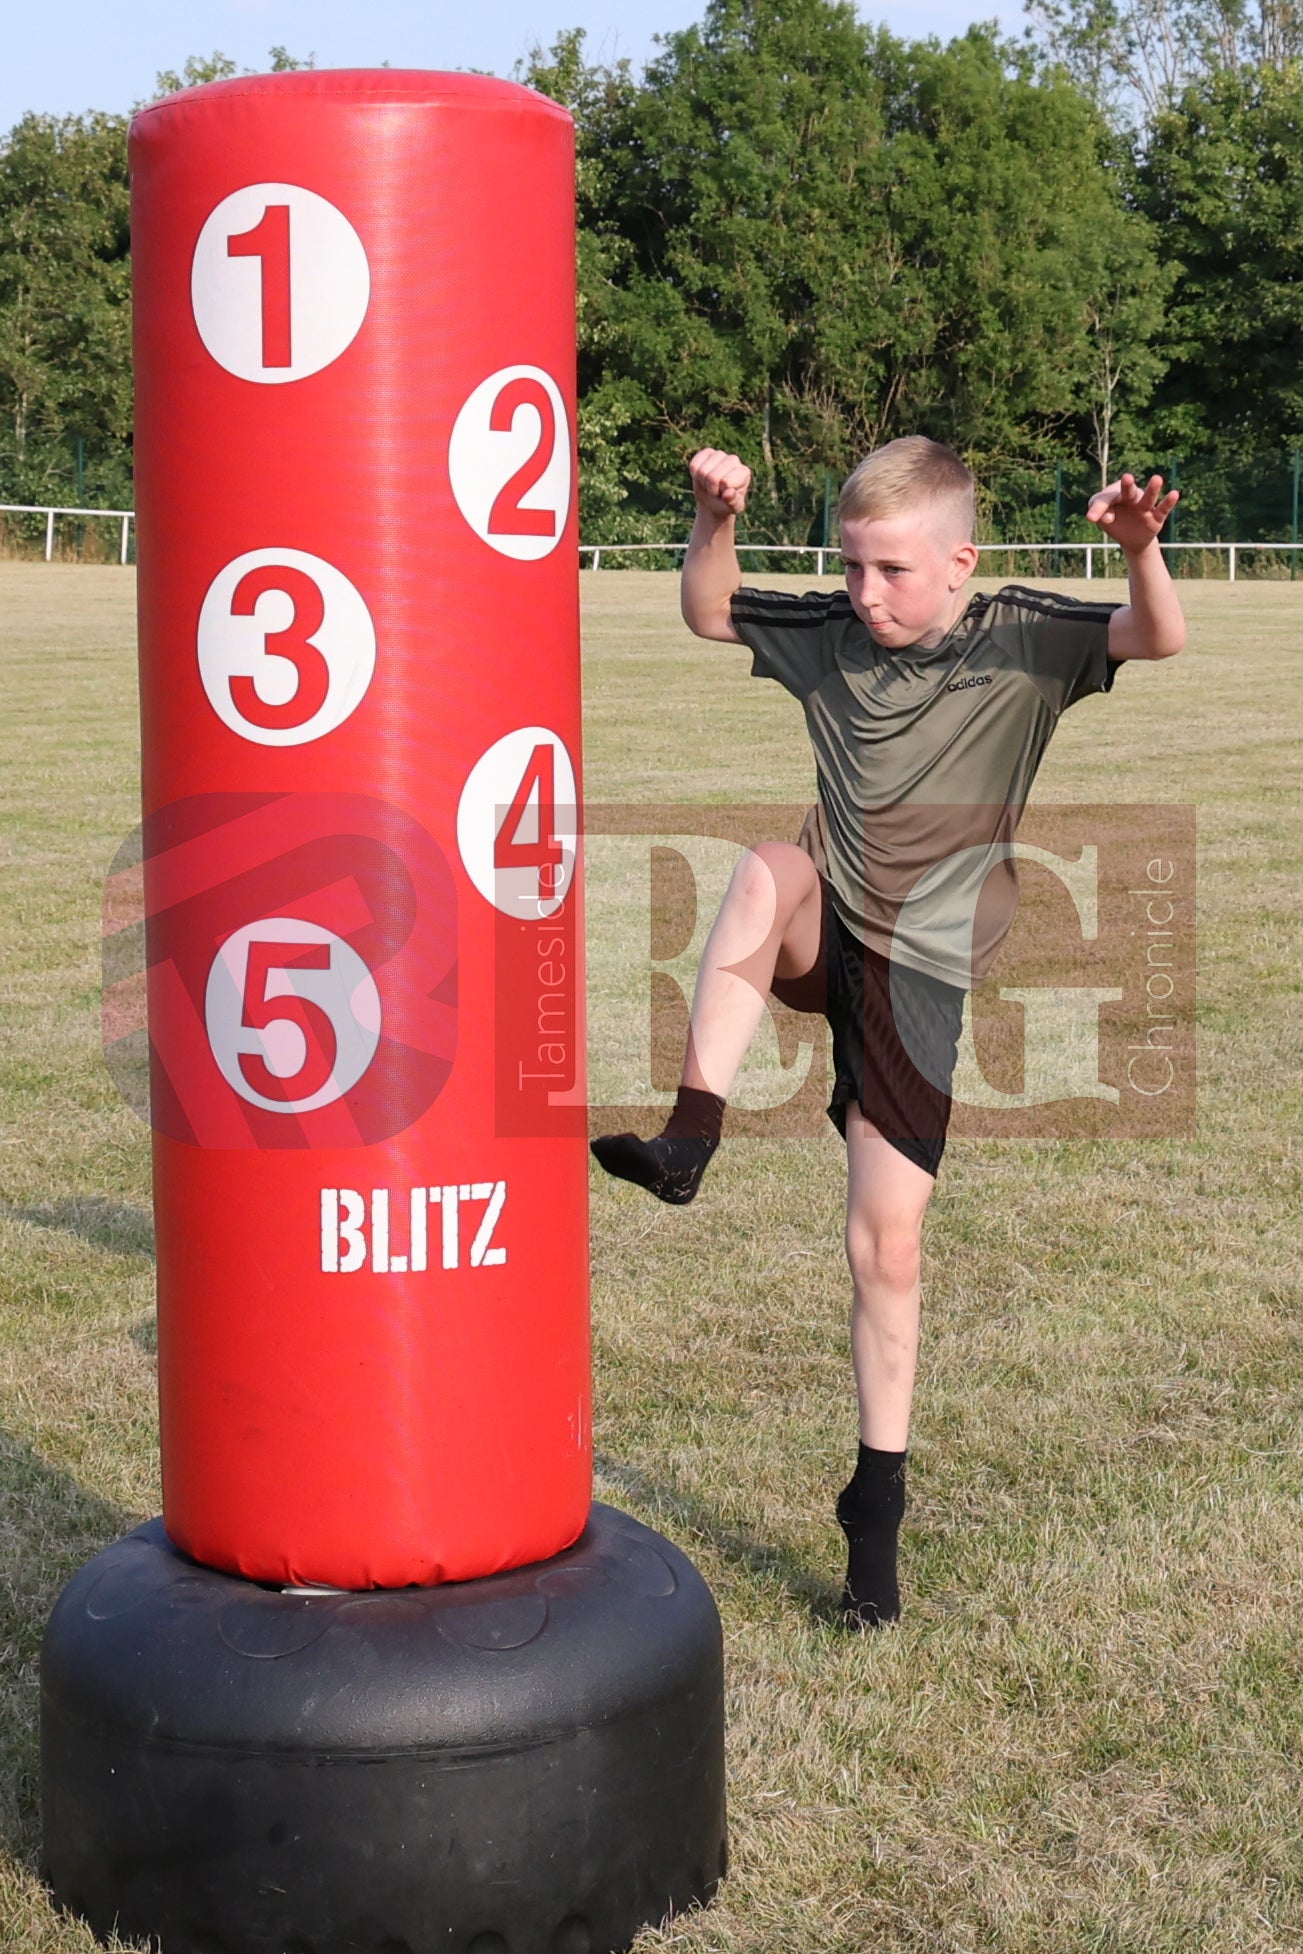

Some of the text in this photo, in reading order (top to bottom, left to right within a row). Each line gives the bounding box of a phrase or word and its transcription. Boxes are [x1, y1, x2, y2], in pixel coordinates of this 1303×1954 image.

[226, 204, 293, 369] 1
[487, 376, 557, 538] 2
[228, 564, 331, 730] 3
[947, 674, 993, 692] adidas
[493, 743, 563, 900] 4
[236, 940, 338, 1103] 5
[320, 1180, 508, 1273] BLITZ
